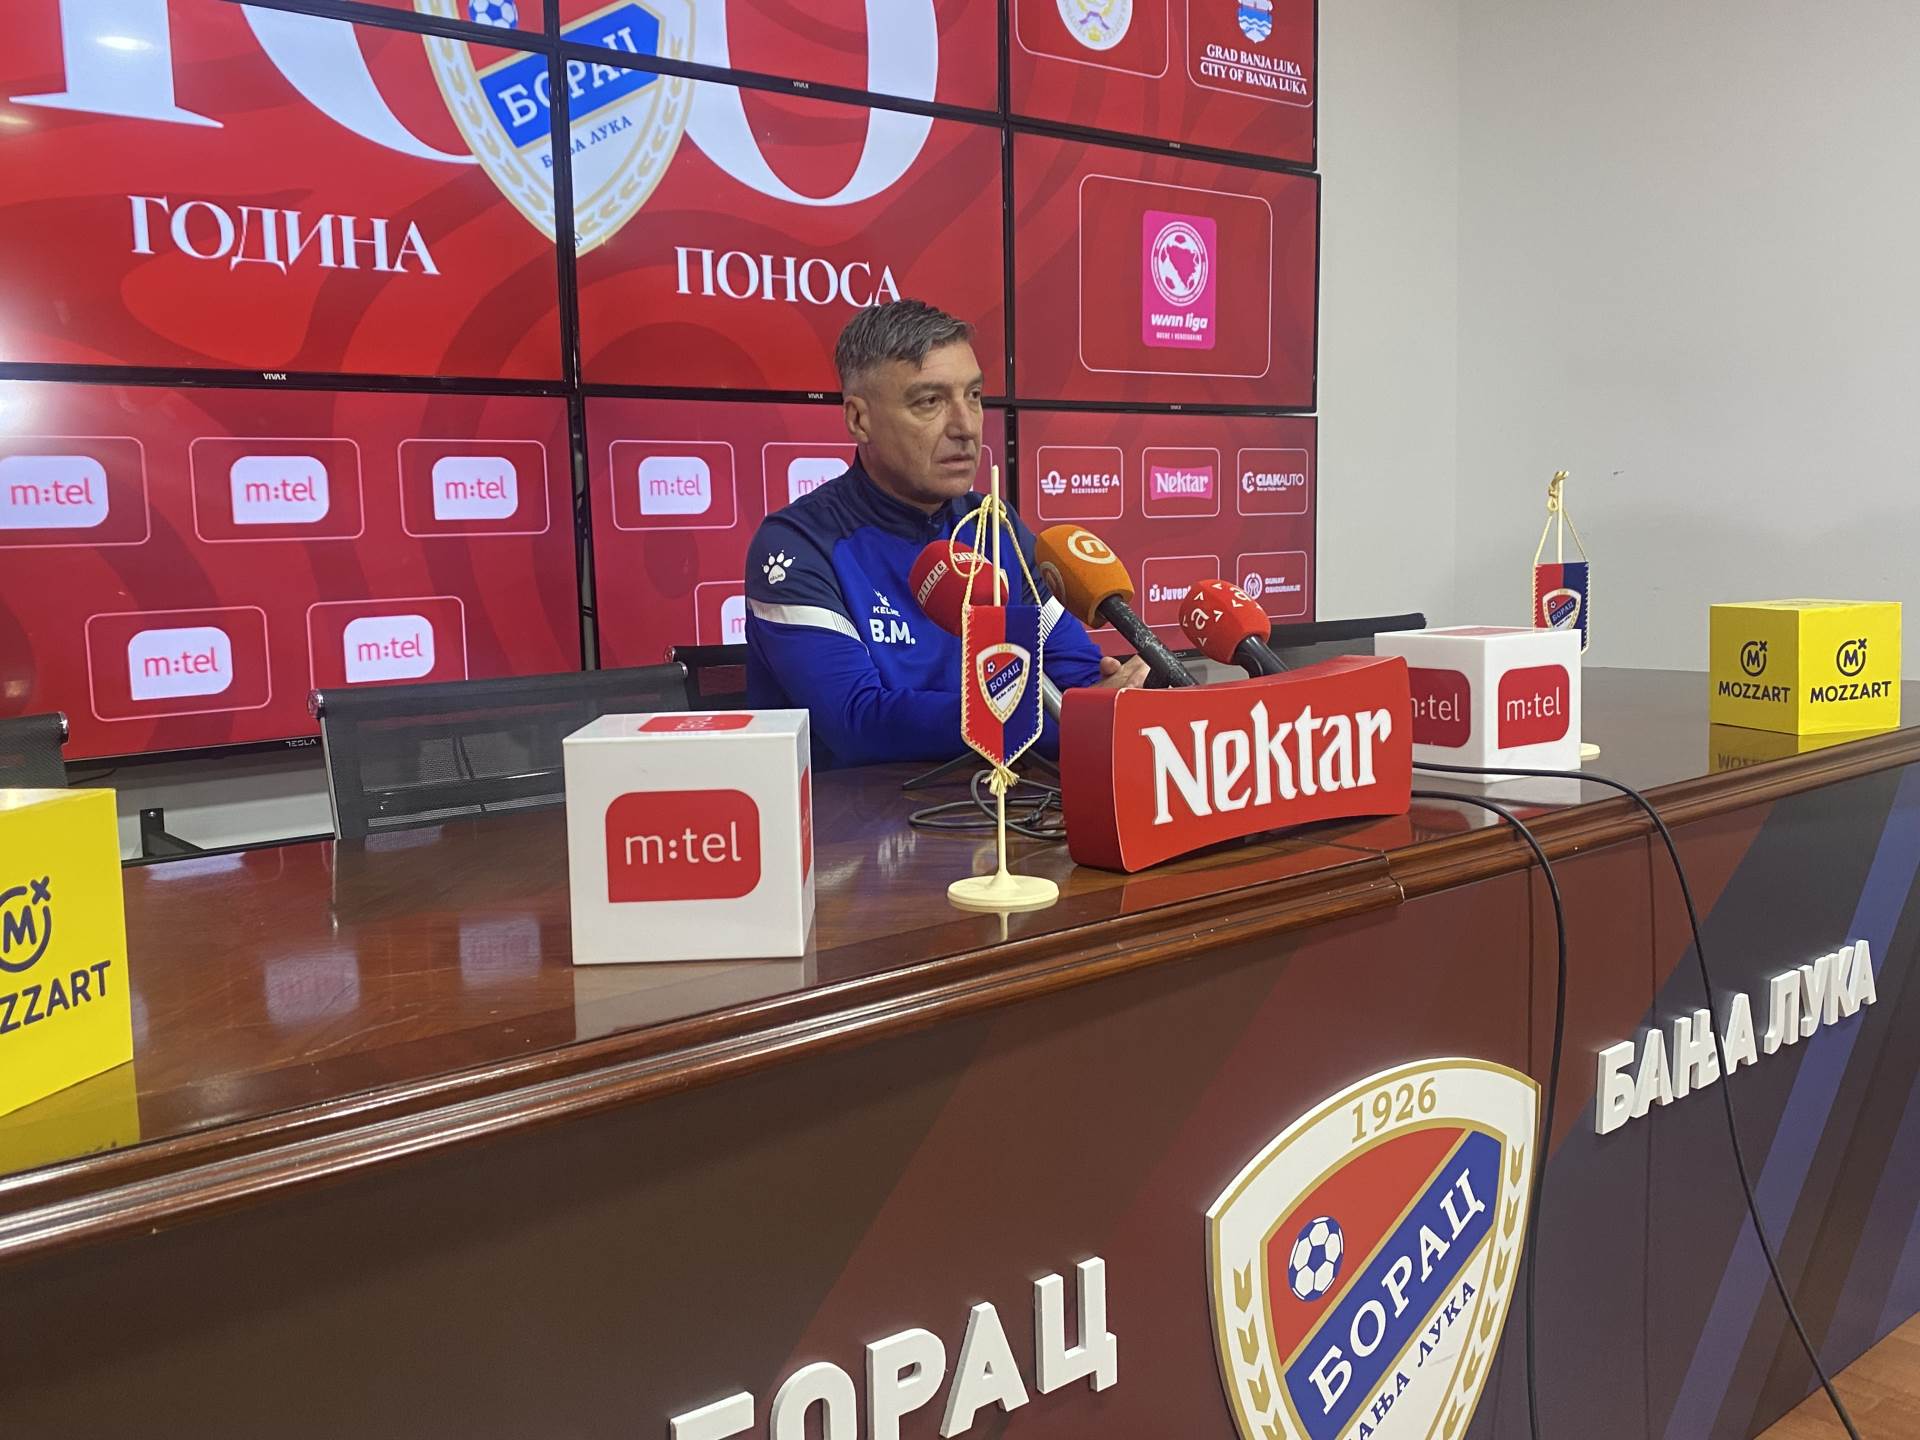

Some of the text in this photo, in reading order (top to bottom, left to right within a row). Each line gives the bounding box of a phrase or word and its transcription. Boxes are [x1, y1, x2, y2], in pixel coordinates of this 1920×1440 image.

[1206, 43, 1301, 76] GRAD BANJA LUKA
[1200, 61, 1307, 95] CITY OF BANJA LUKA
[590, 115, 632, 145] ЛУКА
[127, 195, 440, 275] ГОДИНА
[674, 246, 902, 308] ПОНОСА
[1185, 312, 1209, 332] liga
[262, 372, 287, 381] VIVAX
[10, 477, 96, 506] m:tel
[245, 475, 318, 502] m:tel
[444, 476, 508, 501] m:tel
[649, 473, 702, 497] m:tel
[1071, 474, 1120, 487] OMEGA
[1155, 470, 1209, 493] Nektar
[1161, 586, 1192, 600] Juven
[869, 618, 916, 645] B.M.
[143, 647, 220, 679] m:tel
[357, 634, 425, 662] m:tel
[990, 662, 1020, 693] БОРАЦ
[1718, 681, 1791, 703] MOZZART
[1810, 681, 1892, 704] MOZZART
[1506, 686, 1562, 722] m:tel
[1139, 699, 1392, 826] Nektar
[624, 821, 742, 866] m:tel
[0, 959, 112, 1035] ZZART
[1595, 939, 1877, 1135] БАЊА ЛУКА
[1350, 1076, 1437, 1143] 1926
[1308, 1167, 1486, 1415] БОРАЦ
[1348, 1281, 1476, 1440] АЊА ЛУКА
